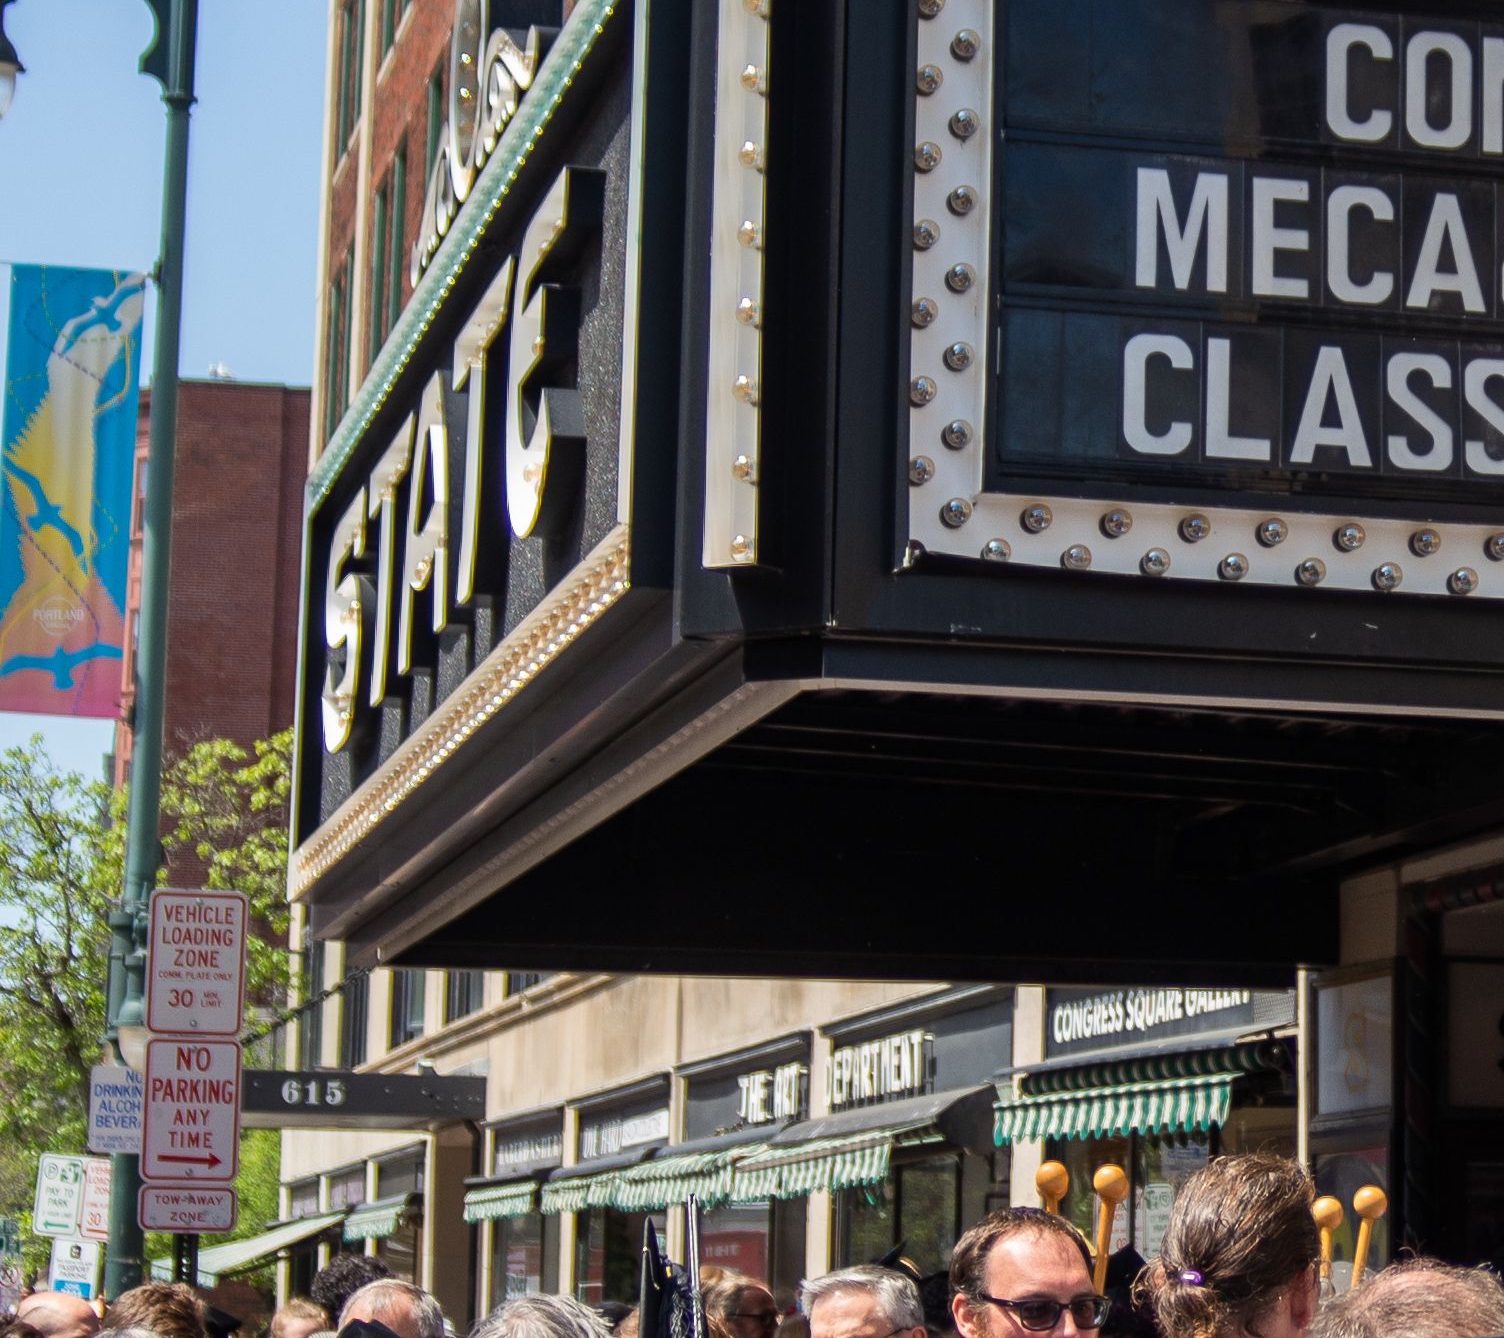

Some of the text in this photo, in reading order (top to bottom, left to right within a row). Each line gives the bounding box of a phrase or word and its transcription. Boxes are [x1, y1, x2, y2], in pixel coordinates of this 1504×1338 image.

[322, 166, 576, 752] STATE
[32, 609, 85, 622] PORTLAND
[163, 904, 235, 925] VEHICLE
[162, 926, 234, 947] LOADING
[173, 949, 220, 969] ZONE
[185, 971, 210, 980] PLATE
[213, 973, 233, 981] ONLY
[167, 988, 194, 1008] 30
[1054, 991, 1125, 1044] CONGRESS
[1125, 989, 1184, 1031] SQUARE
[175, 1046, 212, 1072] NO
[824, 1028, 929, 1116] DEPARTMENT
[94, 1084, 143, 1098] DRINKIN
[151, 1077, 234, 1106] PARKING
[281, 1079, 344, 1107] 615
[736, 1062, 808, 1124] THE ART
[99, 1100, 141, 1114] ALCOH
[172, 1108, 210, 1126] ANY
[95, 1115, 141, 1129] BEVER
[167, 1130, 214, 1149] TIME
[48, 1197, 68, 1208] PARK
[154, 1194, 224, 1207] TOW-AWAY
[170, 1211, 207, 1223] ZONE
